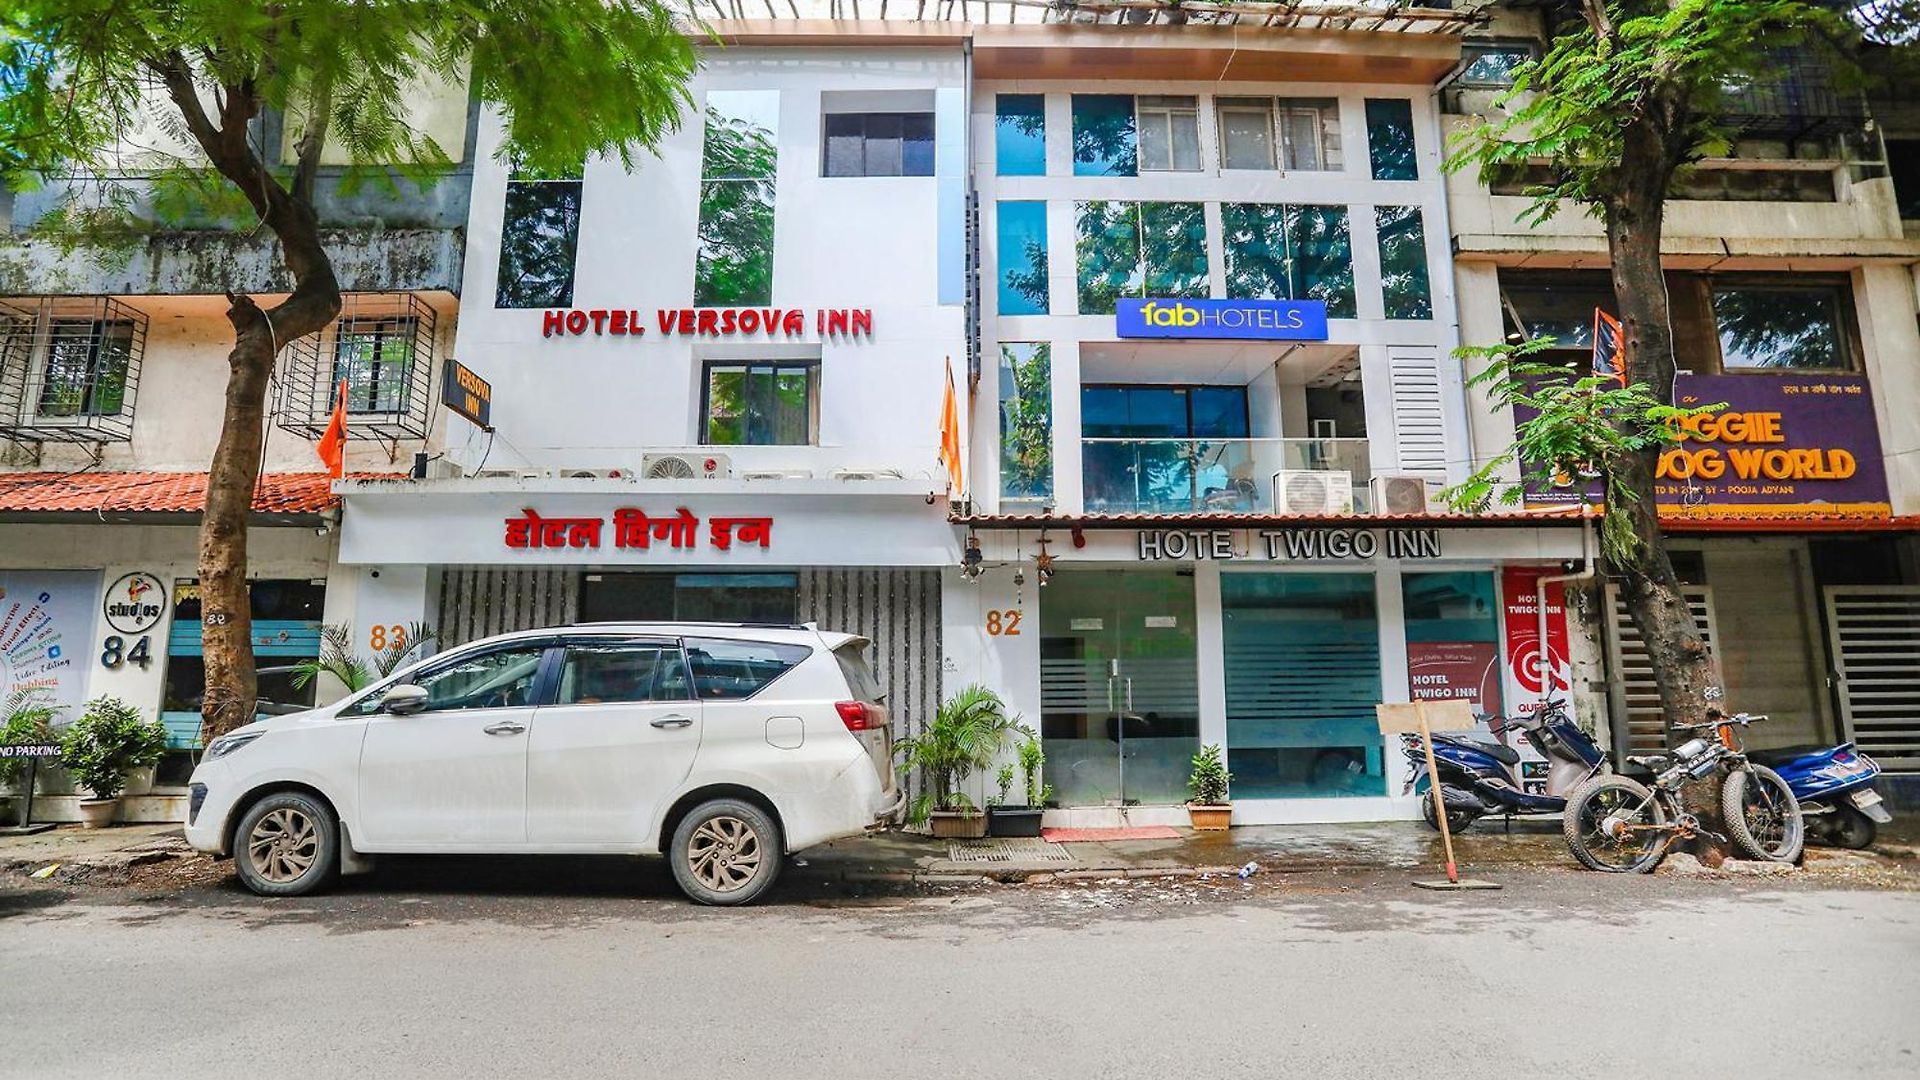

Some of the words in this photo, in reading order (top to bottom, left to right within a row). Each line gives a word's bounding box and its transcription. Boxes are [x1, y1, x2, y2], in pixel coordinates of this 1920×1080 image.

[543, 310, 646, 338] HOTEL
[658, 309, 805, 337] VERSOVA
[817, 309, 872, 336] INN
[456, 363, 490, 403] VERSOVA
[465, 393, 480, 417] INN
[1728, 448, 1856, 480] WORLD
[1727, 485, 1758, 495] POOJA
[1761, 485, 1795, 495] ADVANI
[505, 508, 604, 548] होटल
[709, 518, 773, 551] इन
[1260, 529, 1378, 559] TWIGO
[1387, 530, 1441, 559] INN
[0, 602, 20, 639] RKETING
[986, 609, 1023, 636] 82
[1, 628, 21, 651] Visual
[101, 635, 151, 669] 84
[370, 624, 405, 652] 83
[1412, 674, 1449, 685] HOTEL
[1413, 688, 1452, 698] TWIGO
[1455, 688, 1477, 698] INN
[0, 746, 14, 757] NO
[15, 745, 62, 756] PARKING
